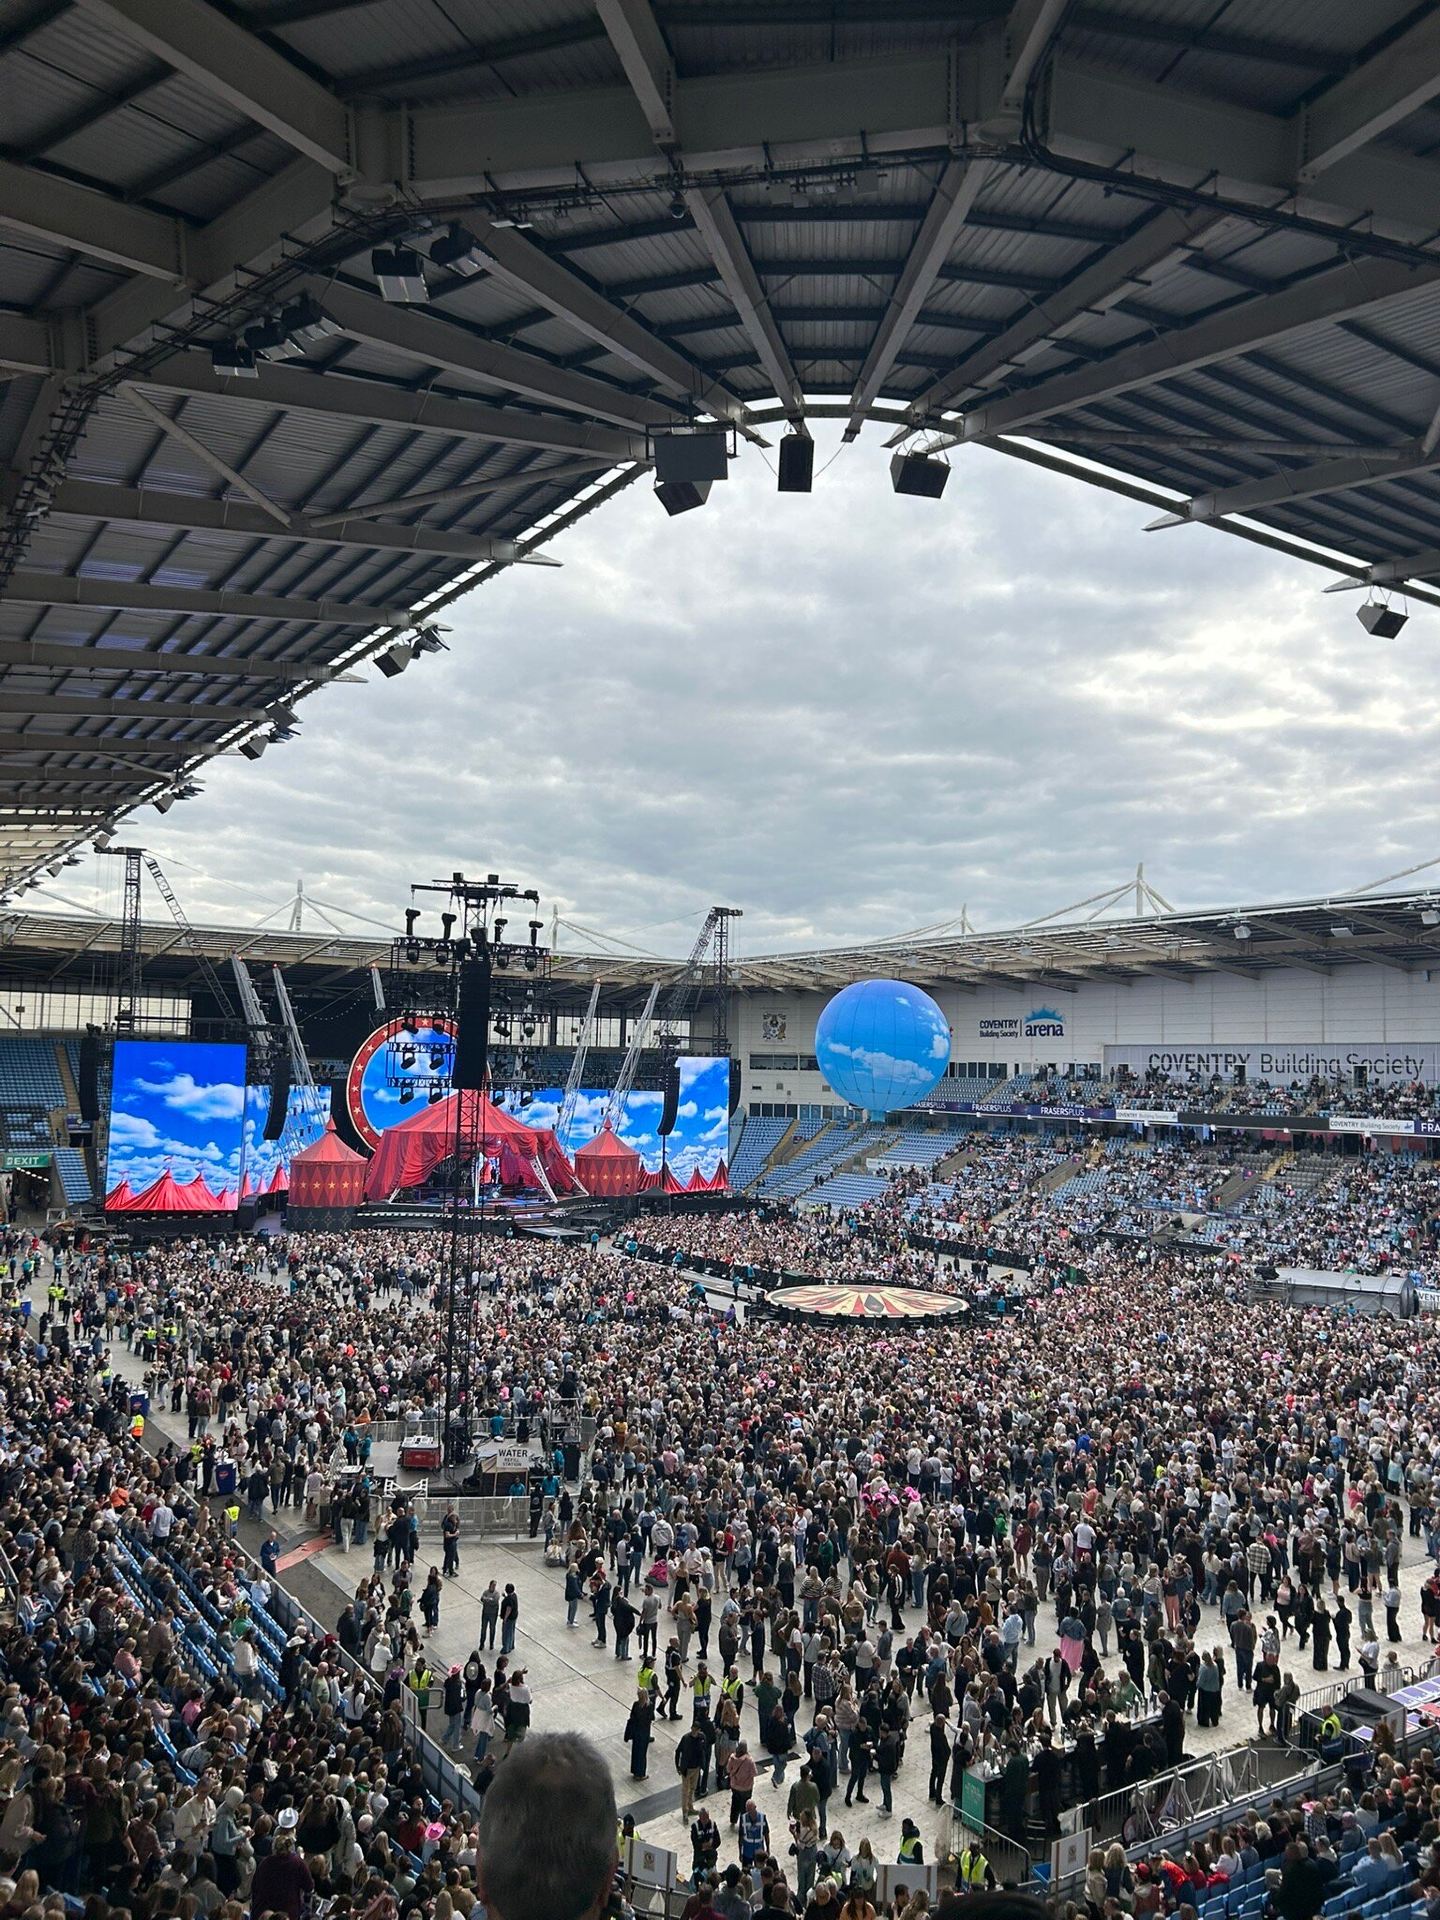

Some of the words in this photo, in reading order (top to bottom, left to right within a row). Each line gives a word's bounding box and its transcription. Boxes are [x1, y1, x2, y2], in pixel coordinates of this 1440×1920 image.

[980, 1019, 1019, 1029] COVENTRY
[980, 1030, 999, 1039] Building
[1000, 1030, 1019, 1039] Society
[1025, 1024, 1064, 1037] arena
[1149, 1053, 1251, 1073] COVENTRY
[1261, 1053, 1341, 1080] Building
[1346, 1053, 1424, 1080] Society
[1040, 1106, 1085, 1117] FRASERSPLUS
[1330, 1120, 1359, 1128] COVENTRY
[1360, 1121, 1382, 1130] Building
[1382, 1122, 1401, 1131] Society
[14, 1156, 39, 1165] EXIT
[499, 1449, 528, 1457] WATER
